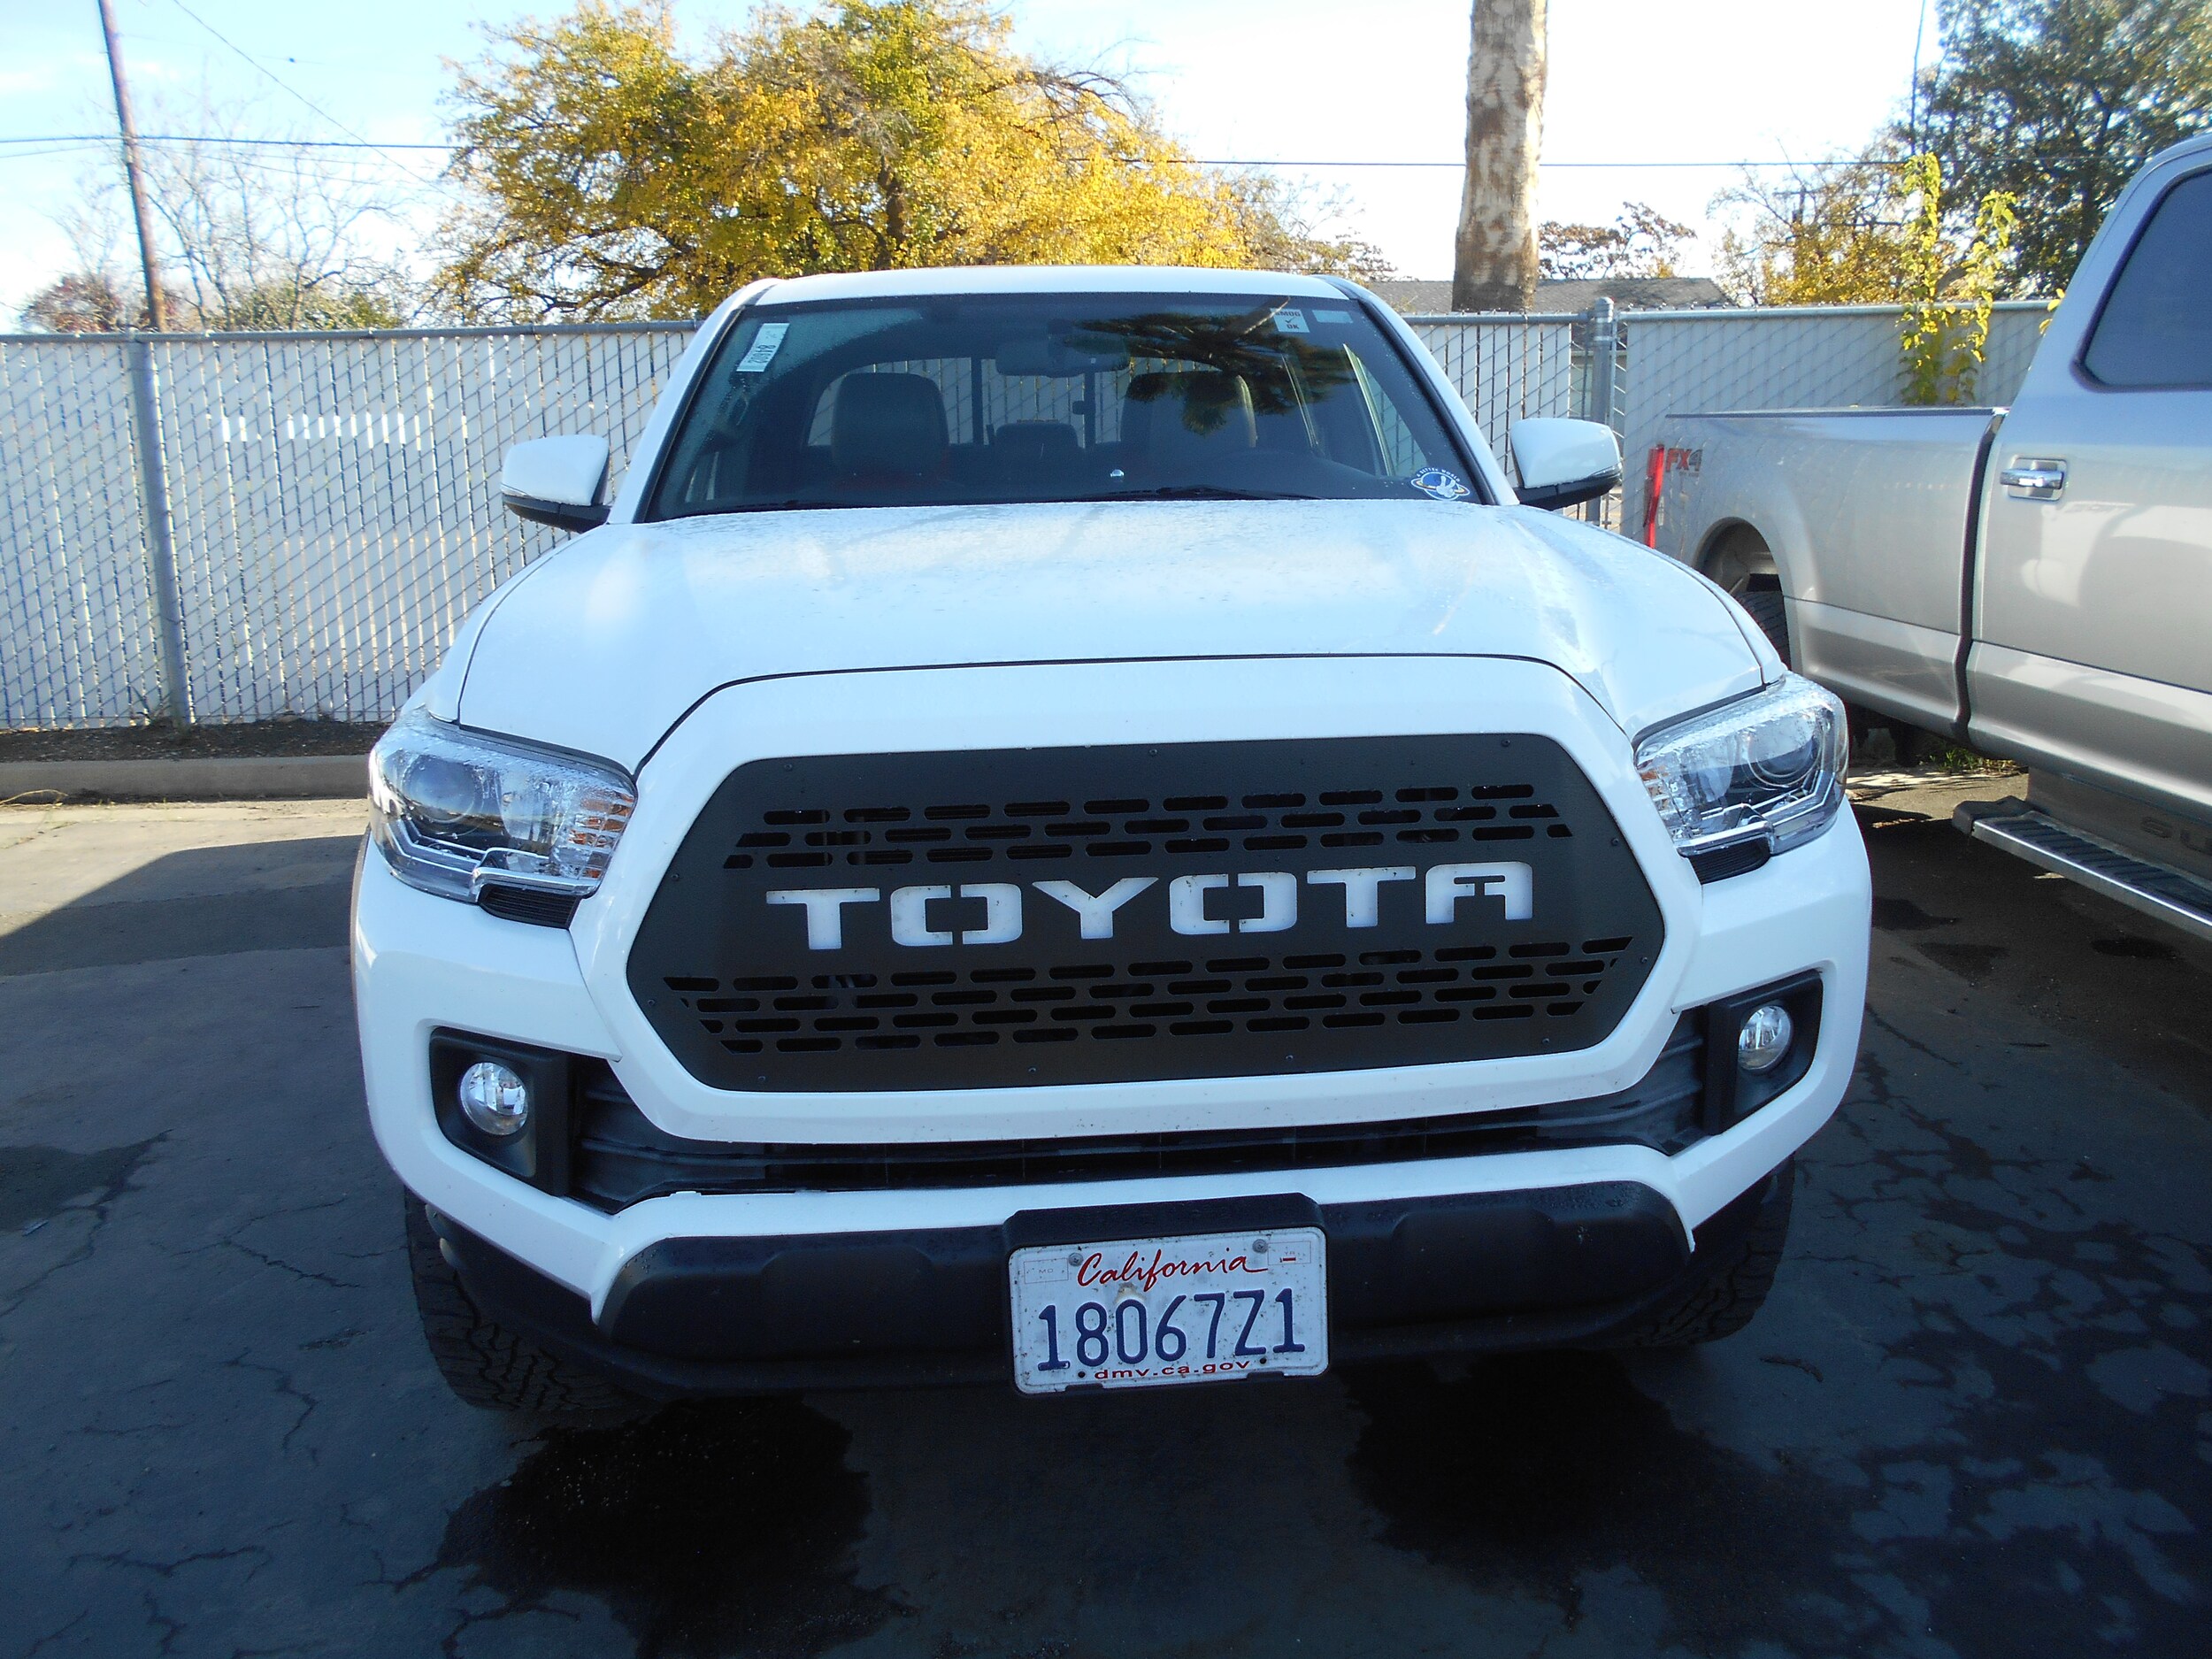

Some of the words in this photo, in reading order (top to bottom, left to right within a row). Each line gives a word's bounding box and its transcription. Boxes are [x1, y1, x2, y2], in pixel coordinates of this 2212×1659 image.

[1441, 469, 1460, 481] WORLD
[1666, 448, 1703, 472] FX4
[765, 861, 1533, 950] TOYOTA
[1077, 1248, 1269, 1292] California
[1038, 1287, 1306, 1372] 18067Z1
[1094, 1360, 1251, 1380] dmv.ca.gov
